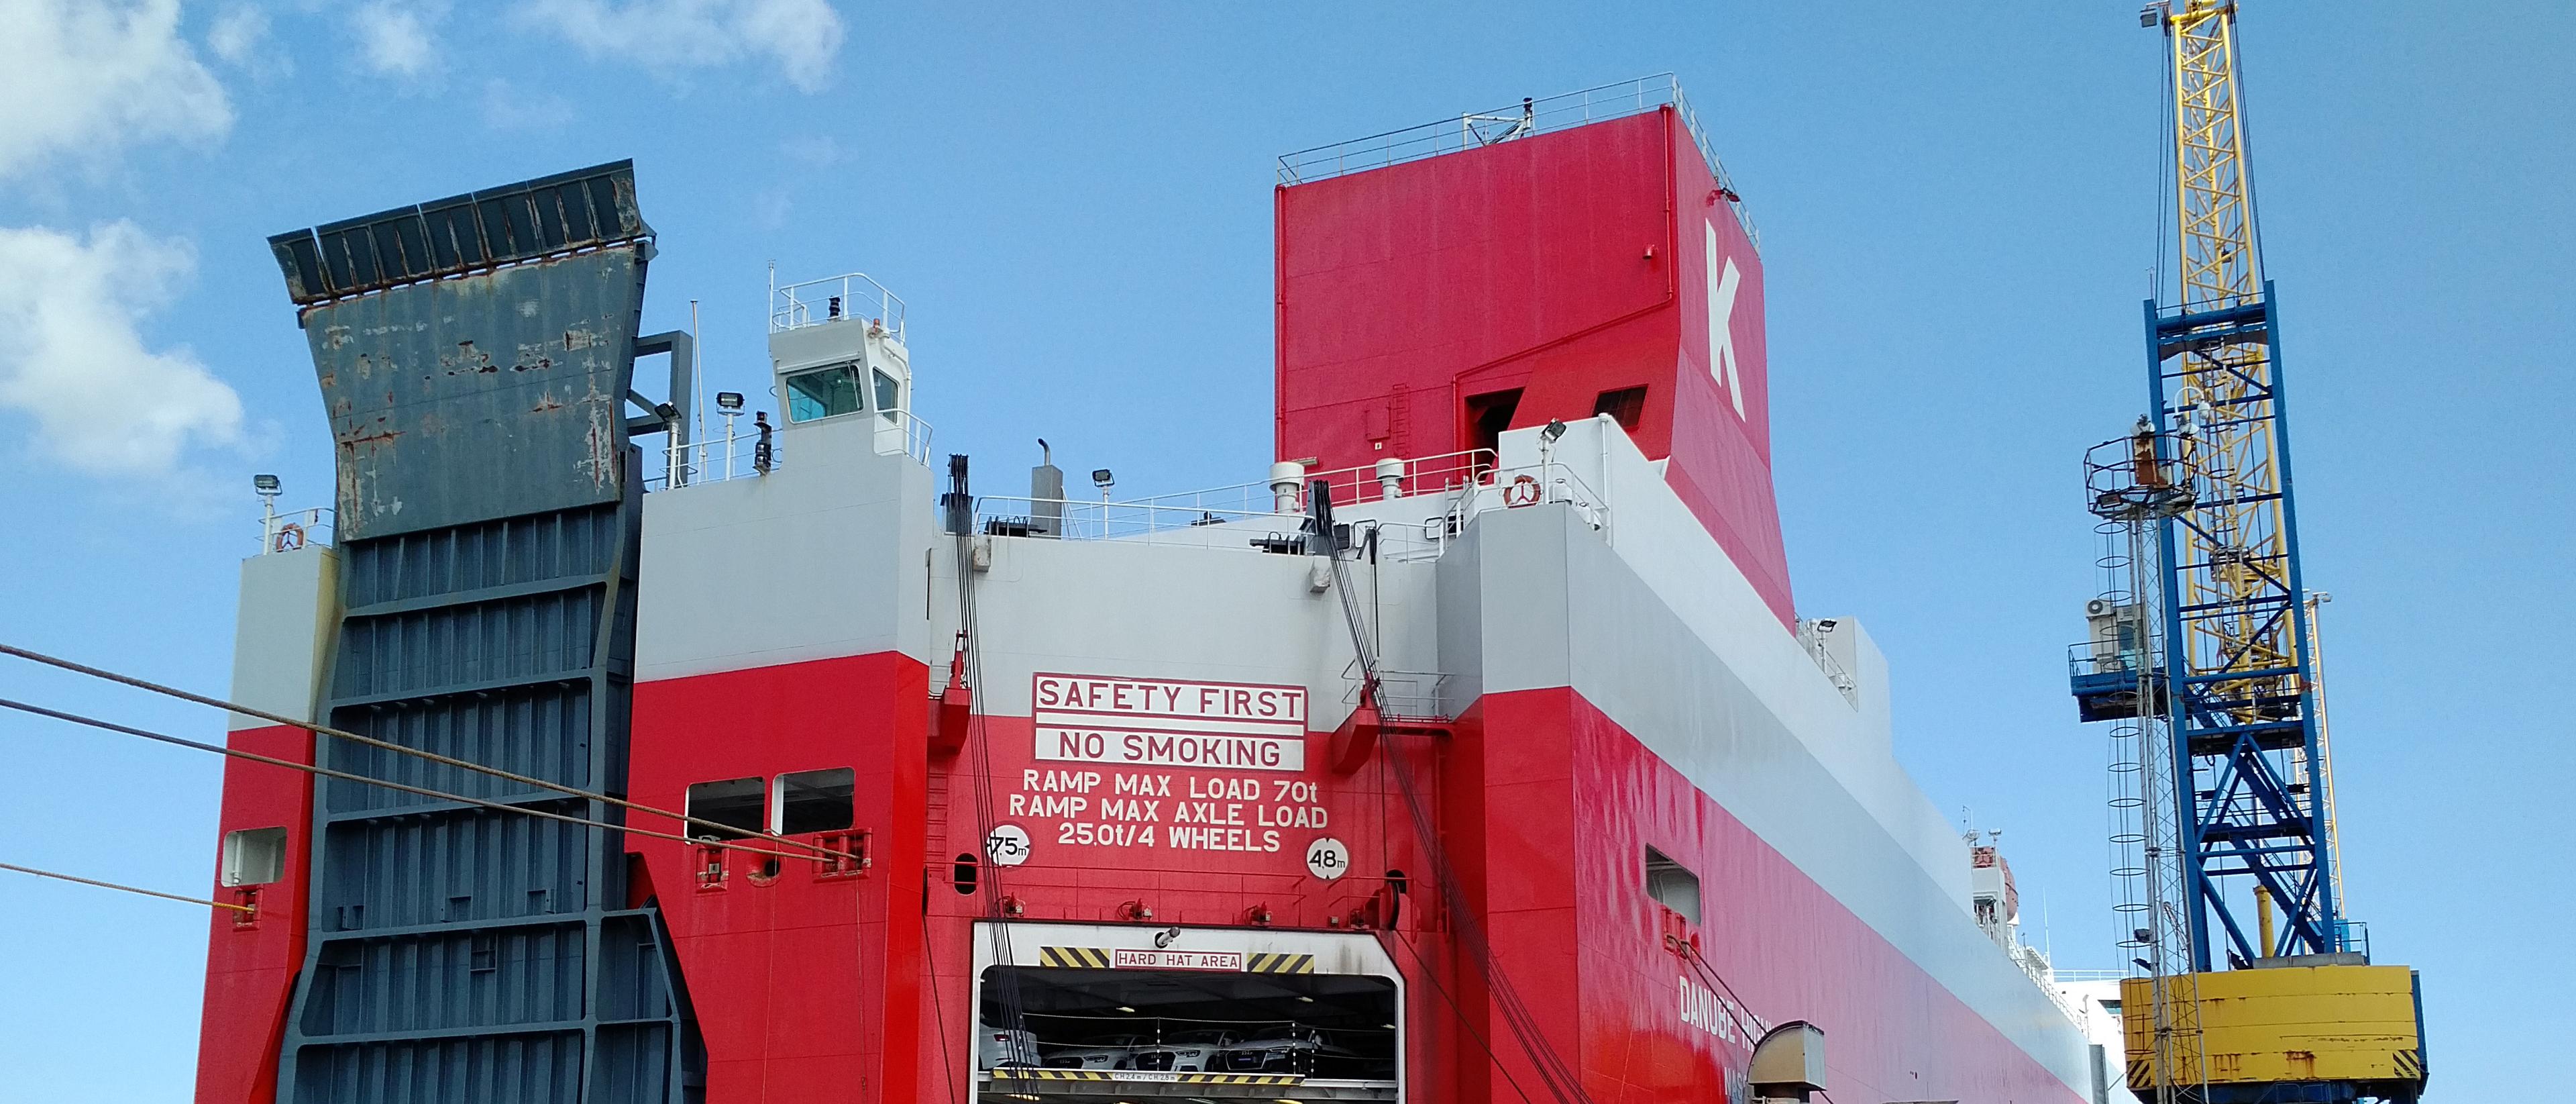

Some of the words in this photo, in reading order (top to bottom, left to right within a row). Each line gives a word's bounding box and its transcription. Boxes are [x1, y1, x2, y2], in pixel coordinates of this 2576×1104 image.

[1705, 217, 1746, 423] K
[1039, 679, 1181, 712] SAFETY
[1199, 688, 1301, 718] FIRST
[1059, 731, 1105, 758] NO
[1122, 734, 1280, 766] SMOKING
[1022, 768, 1101, 794] RAMP
[1115, 773, 1171, 797] MAX
[1189, 776, 1260, 801] LOAD
[1273, 781, 1318, 803] 70t
[1009, 794, 1087, 818] RAMP
[1101, 799, 1160, 823] MAX
[1174, 802, 1245, 826] AXLE
[1258, 805, 1328, 829] LOAD
[1169, 826, 1281, 852] WHEELS
[1118, 952, 1157, 965] HARD
[1166, 954, 1193, 966] HAT
[1200, 955, 1238, 968] AREA
[1679, 975, 1735, 1044] DANUBE
